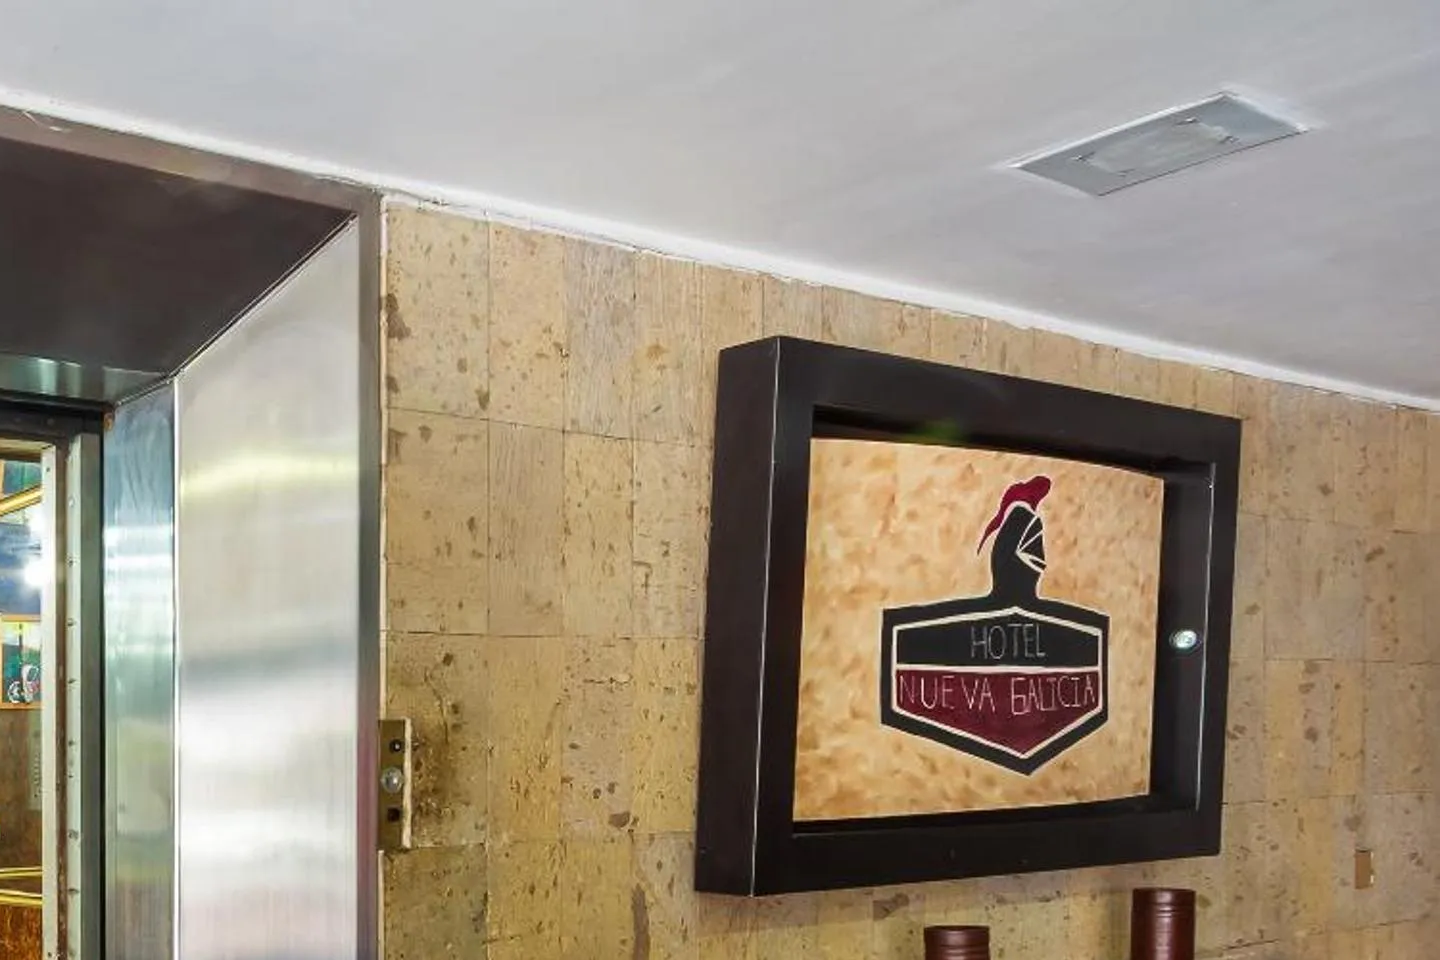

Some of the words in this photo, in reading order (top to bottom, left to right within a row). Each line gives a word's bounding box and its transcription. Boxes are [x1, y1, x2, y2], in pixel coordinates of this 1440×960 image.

[969, 623, 1047, 660] HOTEL
[898, 674, 996, 716] NUEVA
[1010, 673, 1096, 716] GALICIA
